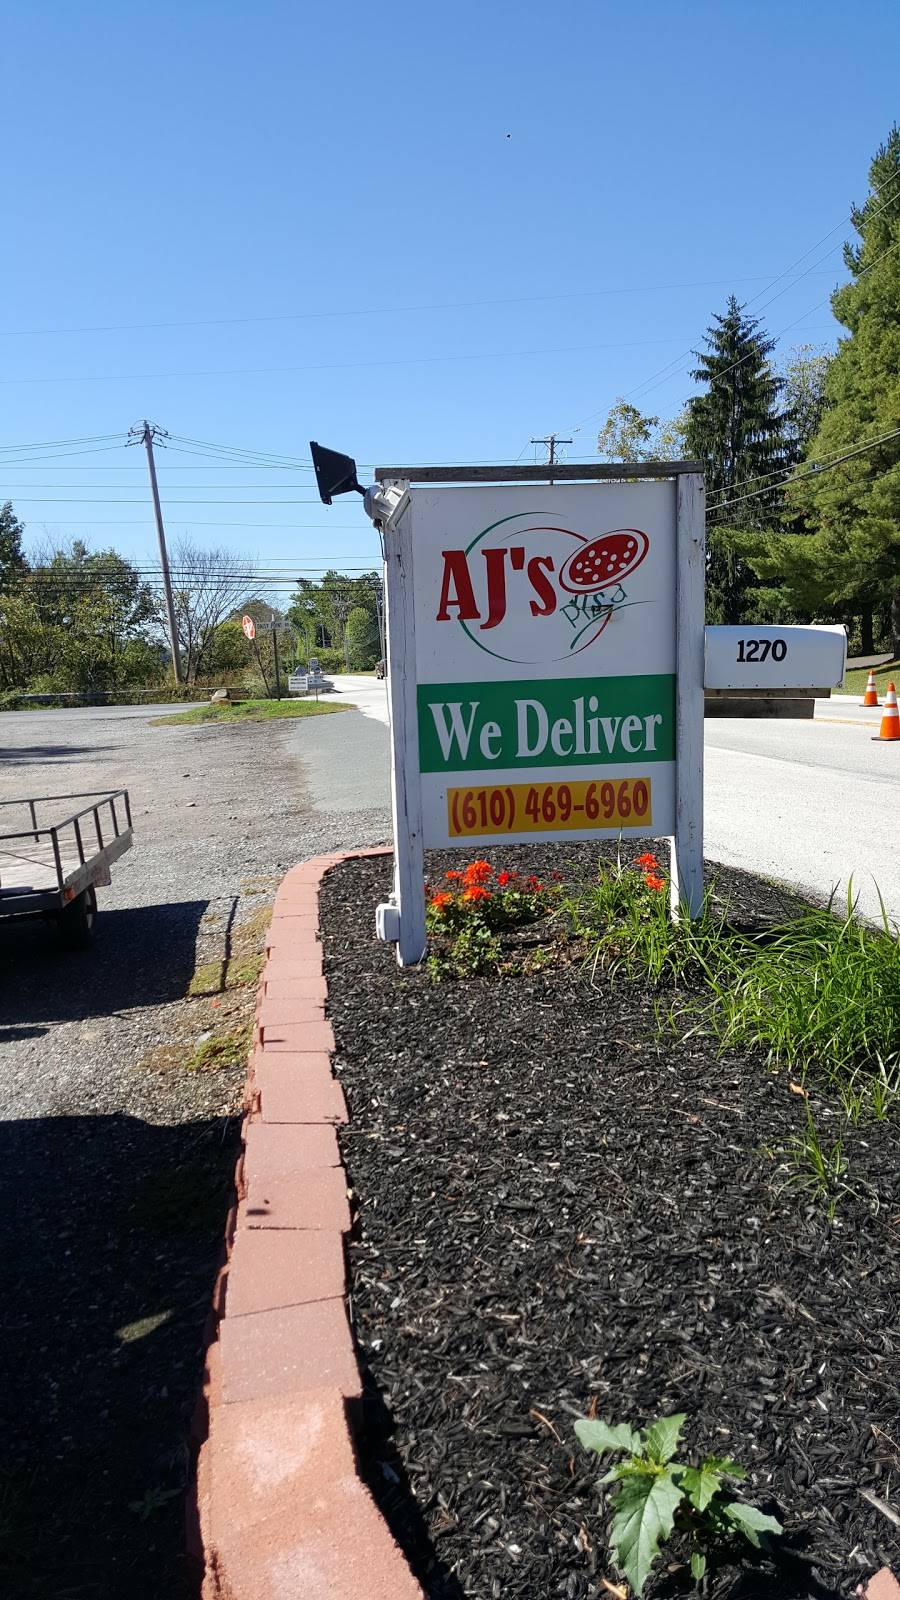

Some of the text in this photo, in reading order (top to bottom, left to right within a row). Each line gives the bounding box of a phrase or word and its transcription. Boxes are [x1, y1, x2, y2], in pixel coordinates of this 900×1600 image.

[736, 639, 788, 663] 1270
[428, 695, 663, 762] We Deliver
[450, 780, 649, 834] (610) 469-6960
